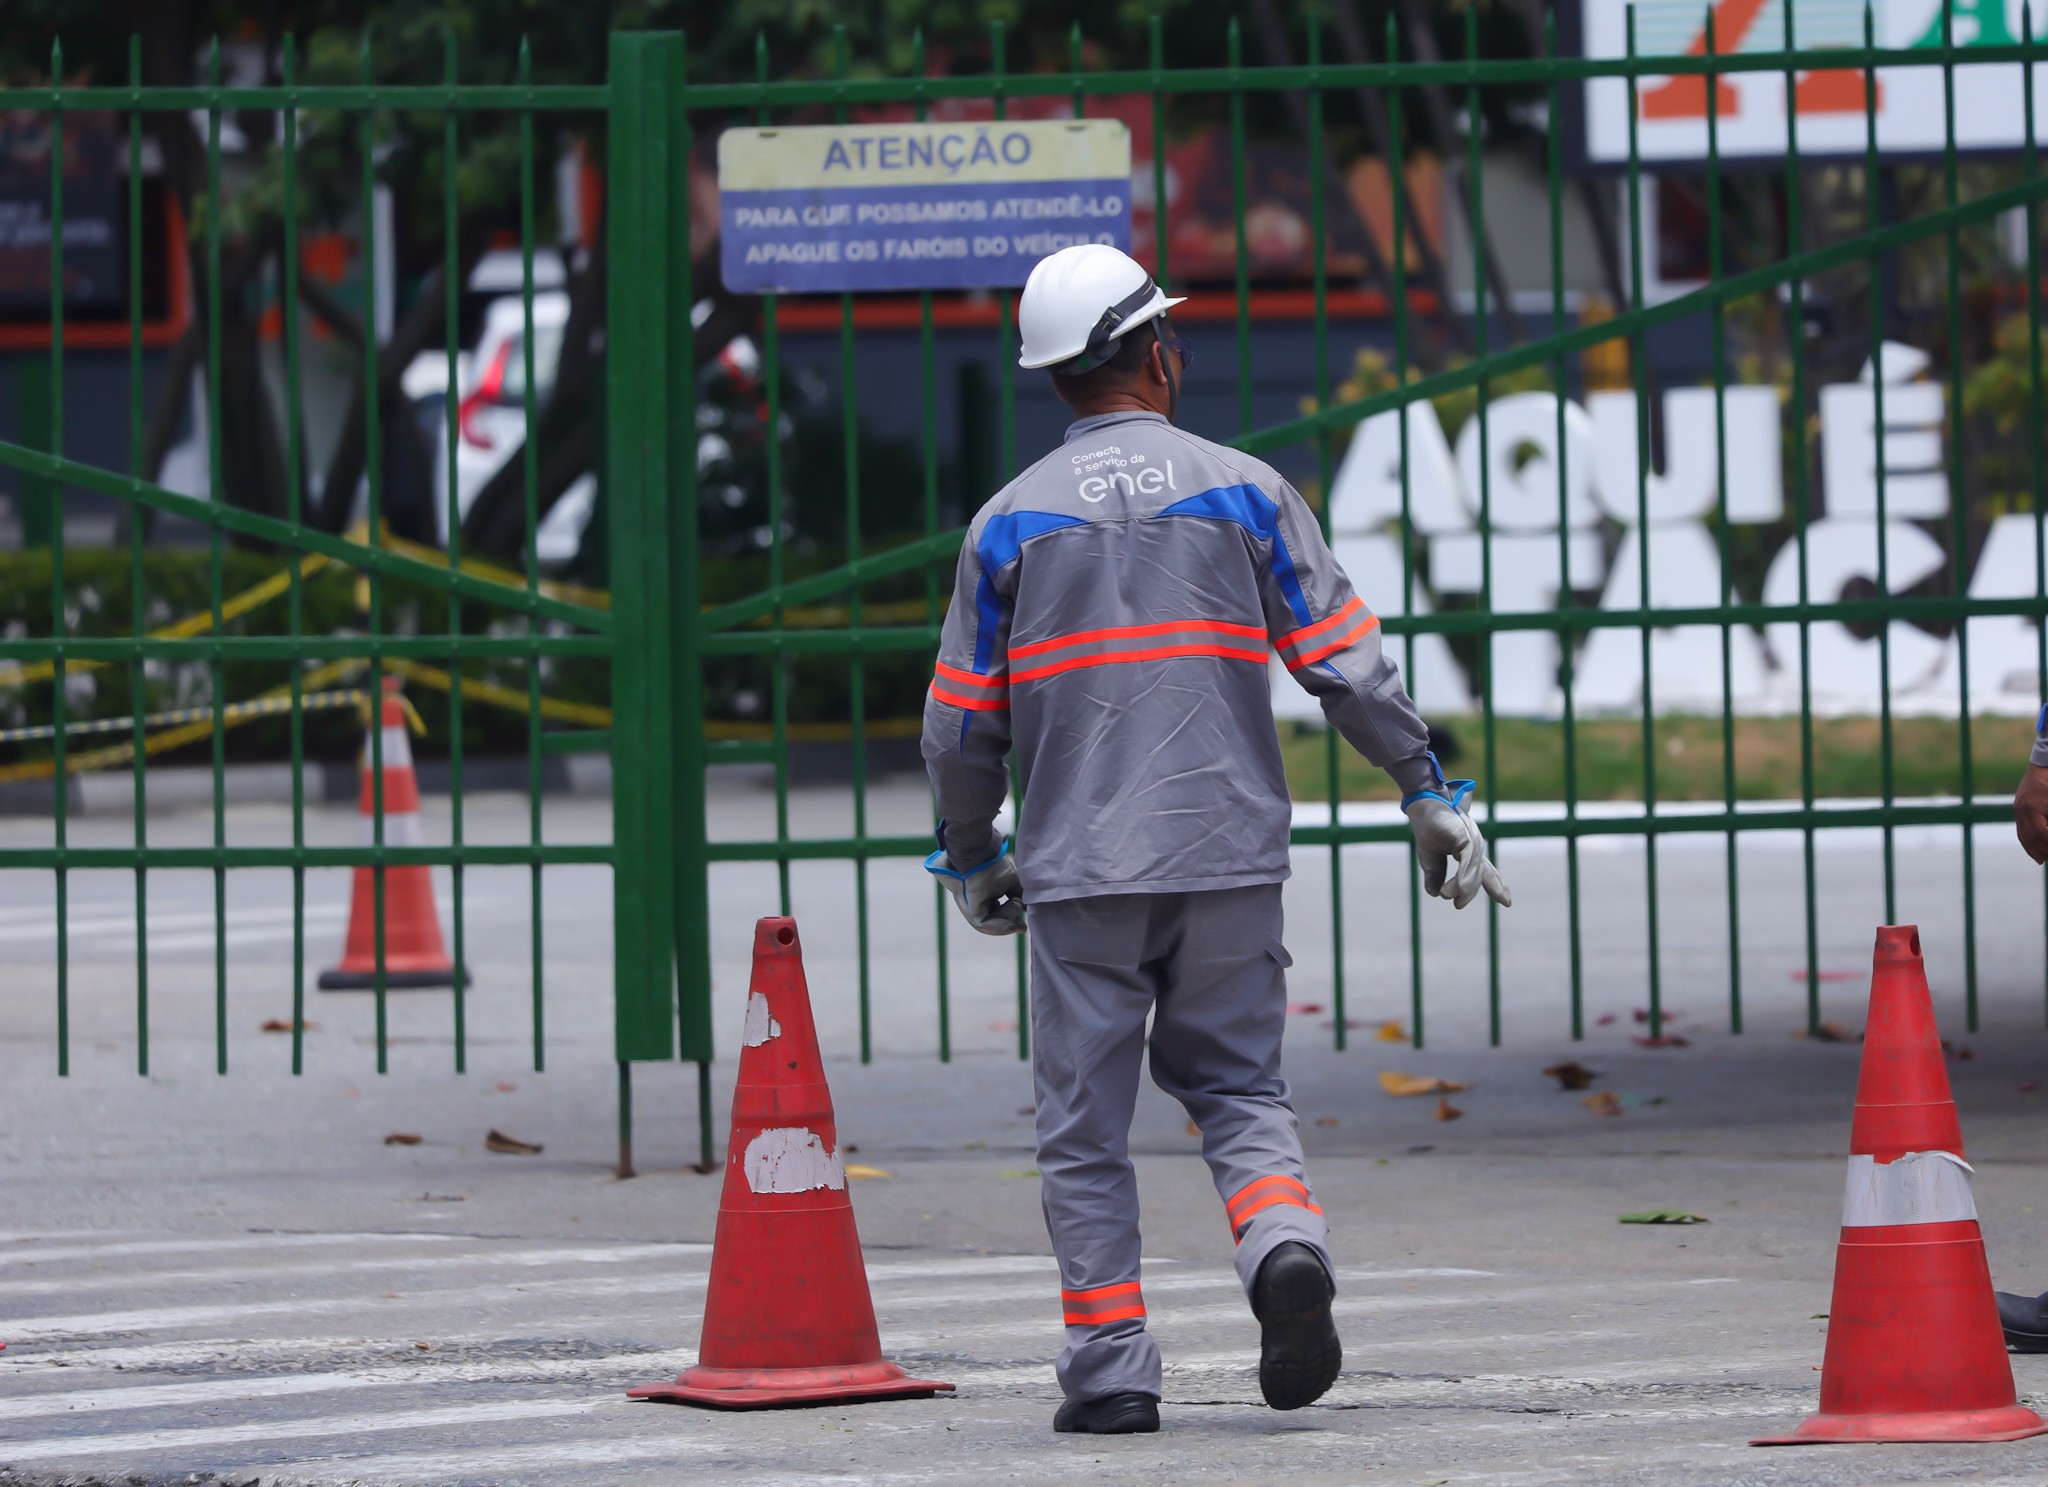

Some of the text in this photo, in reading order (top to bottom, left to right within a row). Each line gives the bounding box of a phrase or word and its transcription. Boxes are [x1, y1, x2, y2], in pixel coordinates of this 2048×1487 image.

[823, 128, 1032, 176] ATENÇÃO
[736, 193, 1123, 227] PARA QUE POSSAMOS ATENDÊ-LO
[745, 240, 840, 265] APAGUE
[846, 240, 879, 261] OS
[884, 234, 968, 261] FARÓIS
[973, 235, 1009, 257] DO
[1072, 446, 1121, 464] Conecta
[1074, 454, 1146, 475] a serviço da
[1079, 460, 1177, 503] enel
